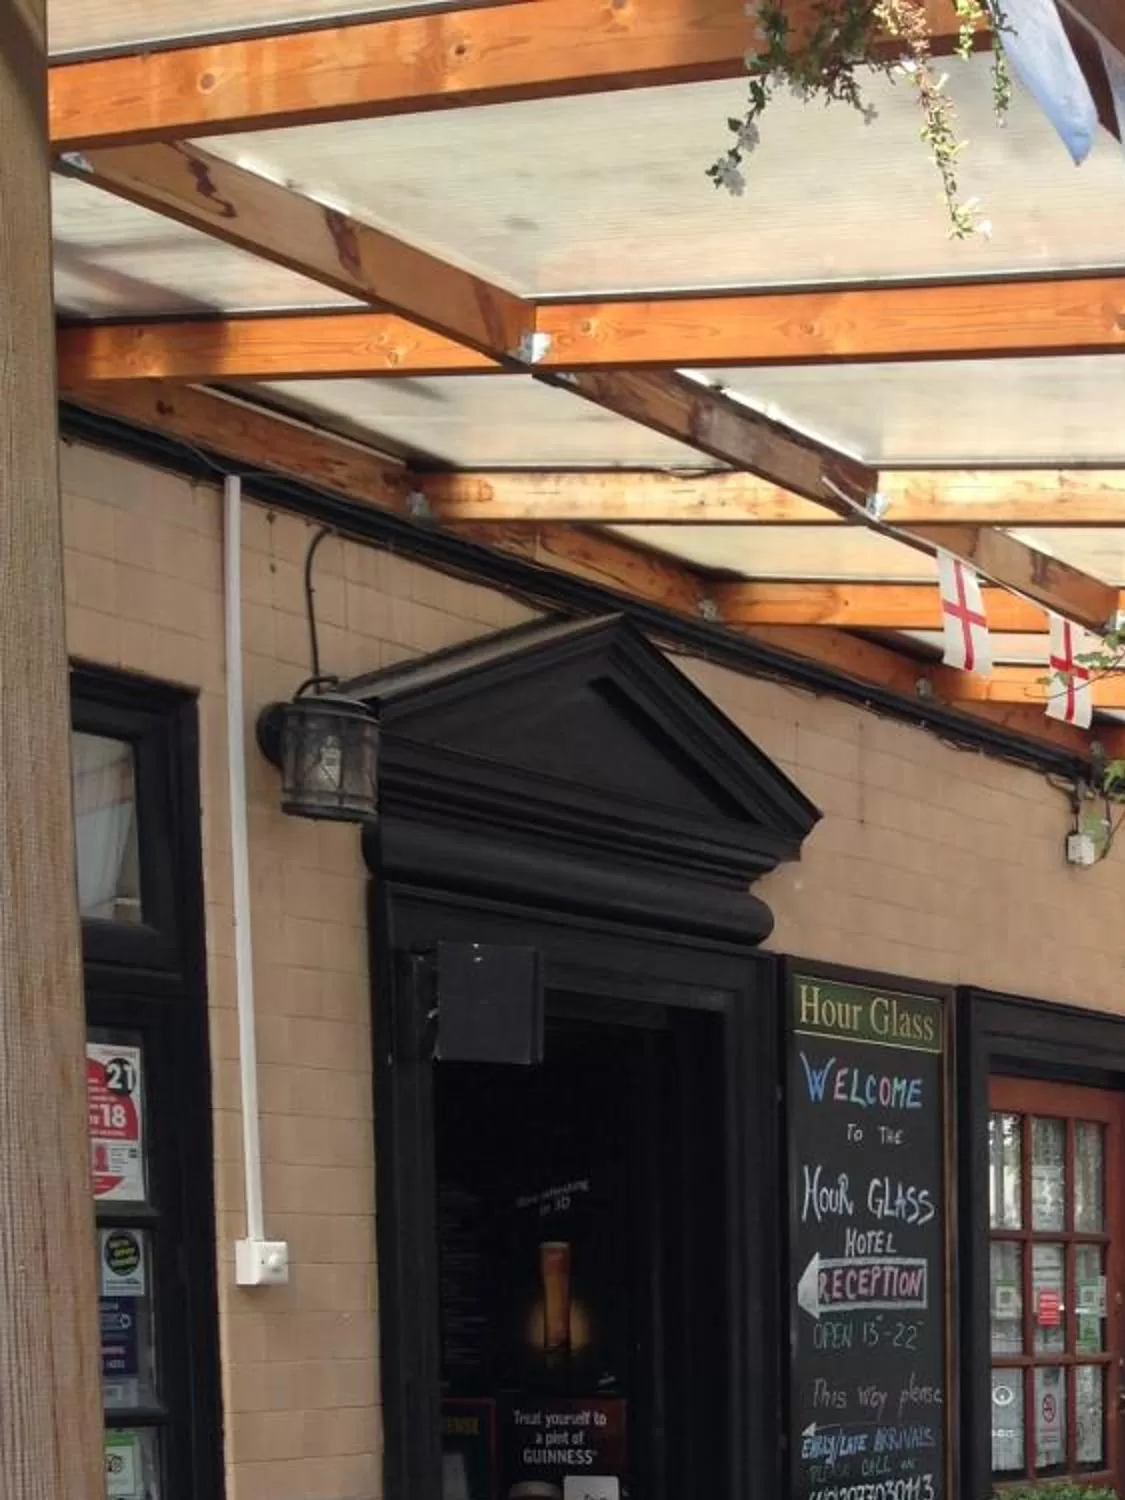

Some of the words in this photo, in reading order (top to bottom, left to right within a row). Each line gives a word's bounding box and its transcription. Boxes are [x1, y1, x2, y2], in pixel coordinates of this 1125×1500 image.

[800, 984, 863, 1028] Hour
[870, 997, 935, 1042] Glass
[107, 1062, 135, 1091] 21
[800, 1051, 923, 1109] WELCOME
[100, 1103, 128, 1129] 18
[867, 1176, 936, 1227] GLASS
[845, 1227, 897, 1258] HOTEL
[817, 1266, 923, 1303] RECEPTION
[813, 1321, 853, 1350] OPEN
[812, 1378, 847, 1409] This
[513, 1409, 541, 1425] Treat
[545, 1410, 591, 1429] yourself
[593, 1410, 608, 1426] to
[536, 1432, 543, 1445] a
[545, 1431, 569, 1447] pint
[571, 1430, 585, 1445] of
[523, 1448, 593, 1465] GUINNESS
